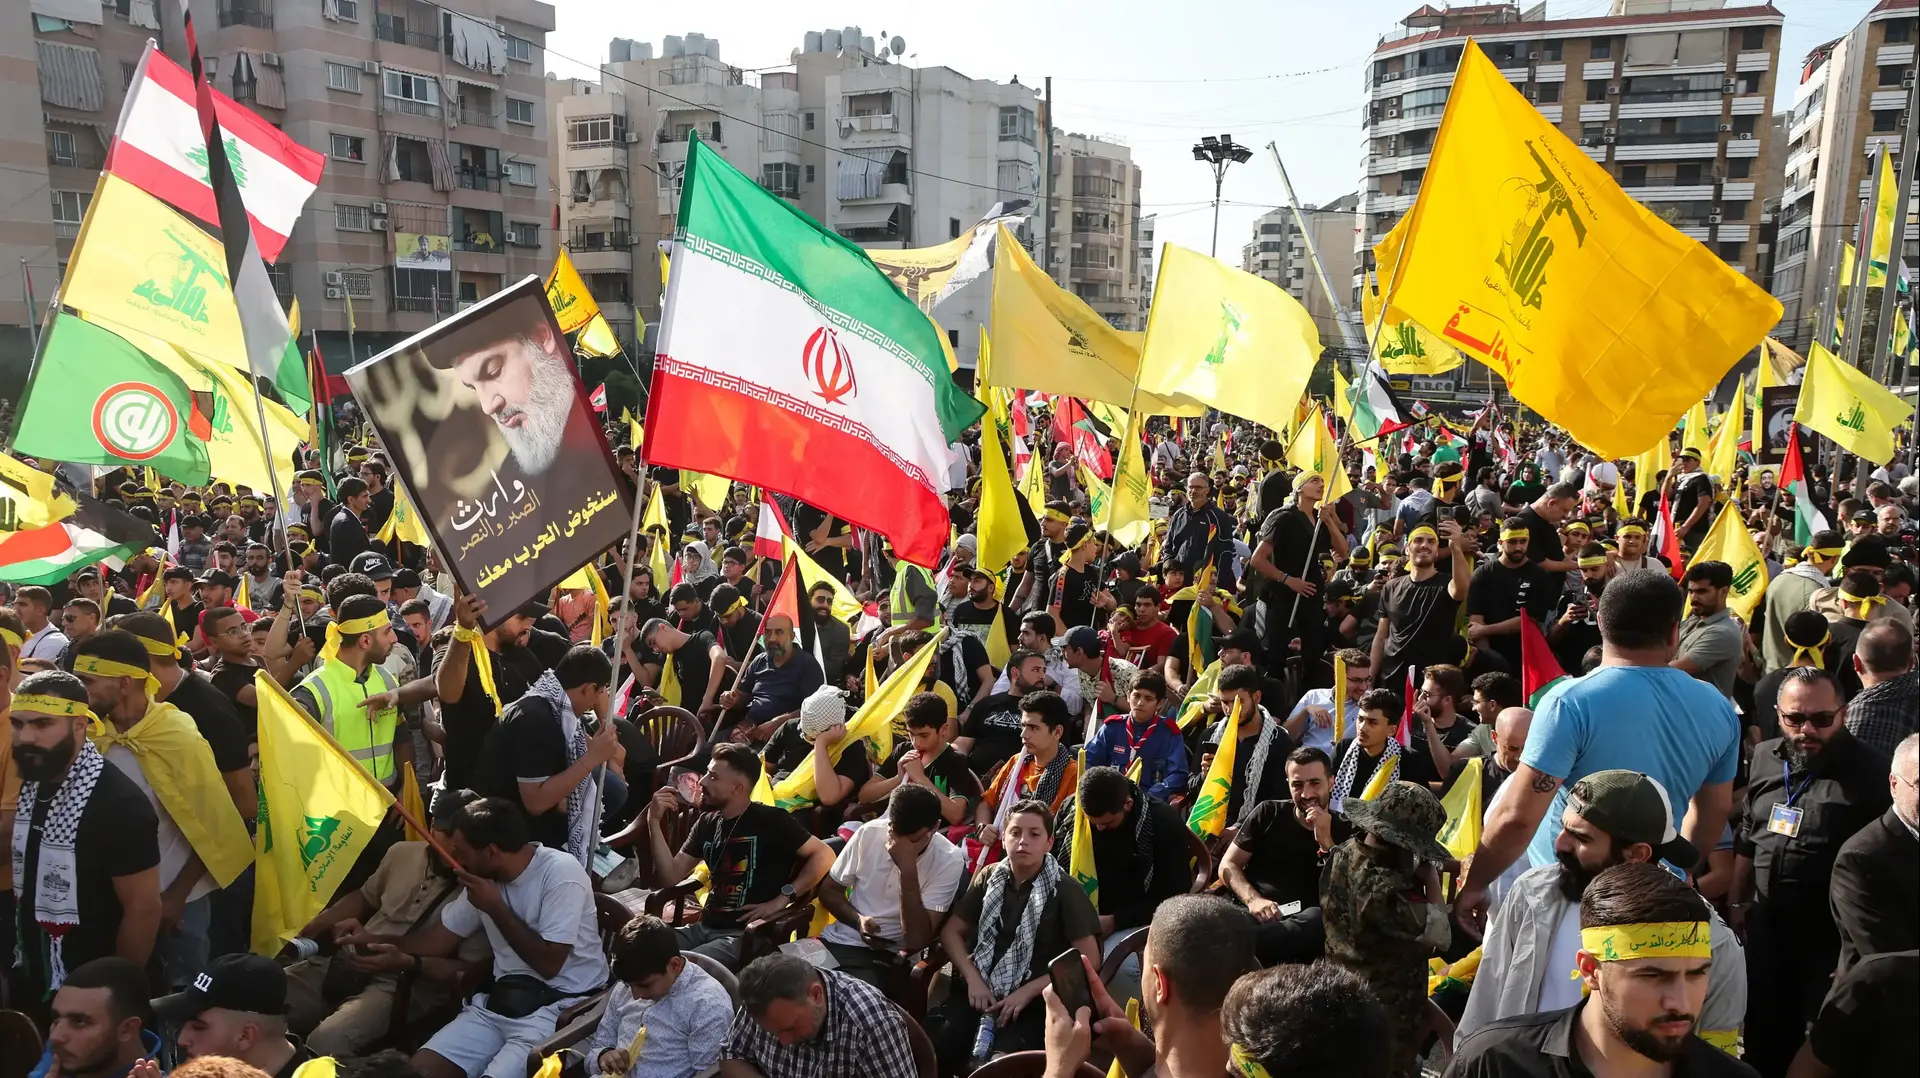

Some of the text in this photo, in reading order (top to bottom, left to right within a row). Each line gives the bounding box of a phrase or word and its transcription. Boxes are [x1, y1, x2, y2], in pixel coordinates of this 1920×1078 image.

[450, 468, 525, 531] وارث
[506, 488, 541, 530] الصبر
[476, 489, 618, 589] سنخوض الحرب معك
[365, 558, 381, 566] NIKE
[1629, 934, 1664, 951] القدس
